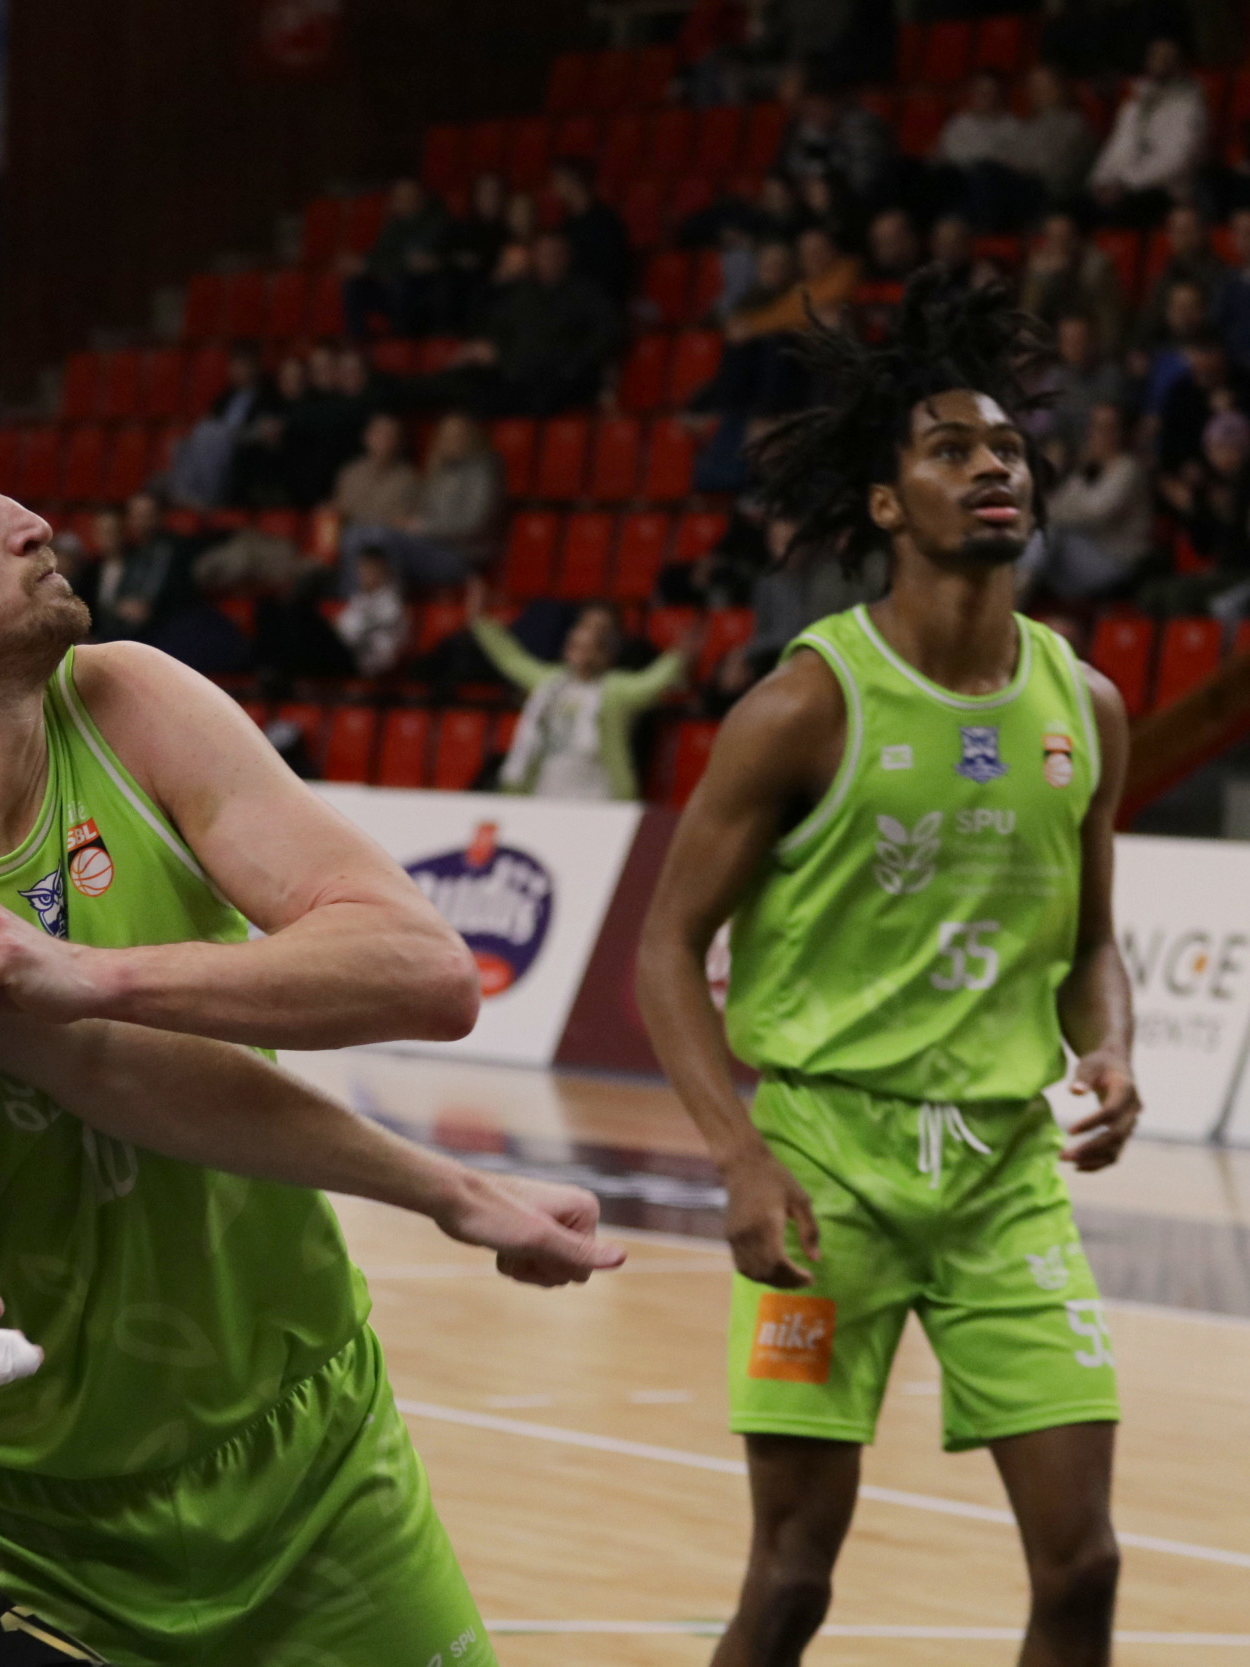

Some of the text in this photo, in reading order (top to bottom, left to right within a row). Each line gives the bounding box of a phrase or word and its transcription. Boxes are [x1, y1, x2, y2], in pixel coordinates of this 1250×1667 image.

[955, 809, 1017, 836] SPU
[930, 920, 999, 990] 55
[1123, 928, 1248, 1001] NGE
[450, 1626, 477, 1658] SPU
